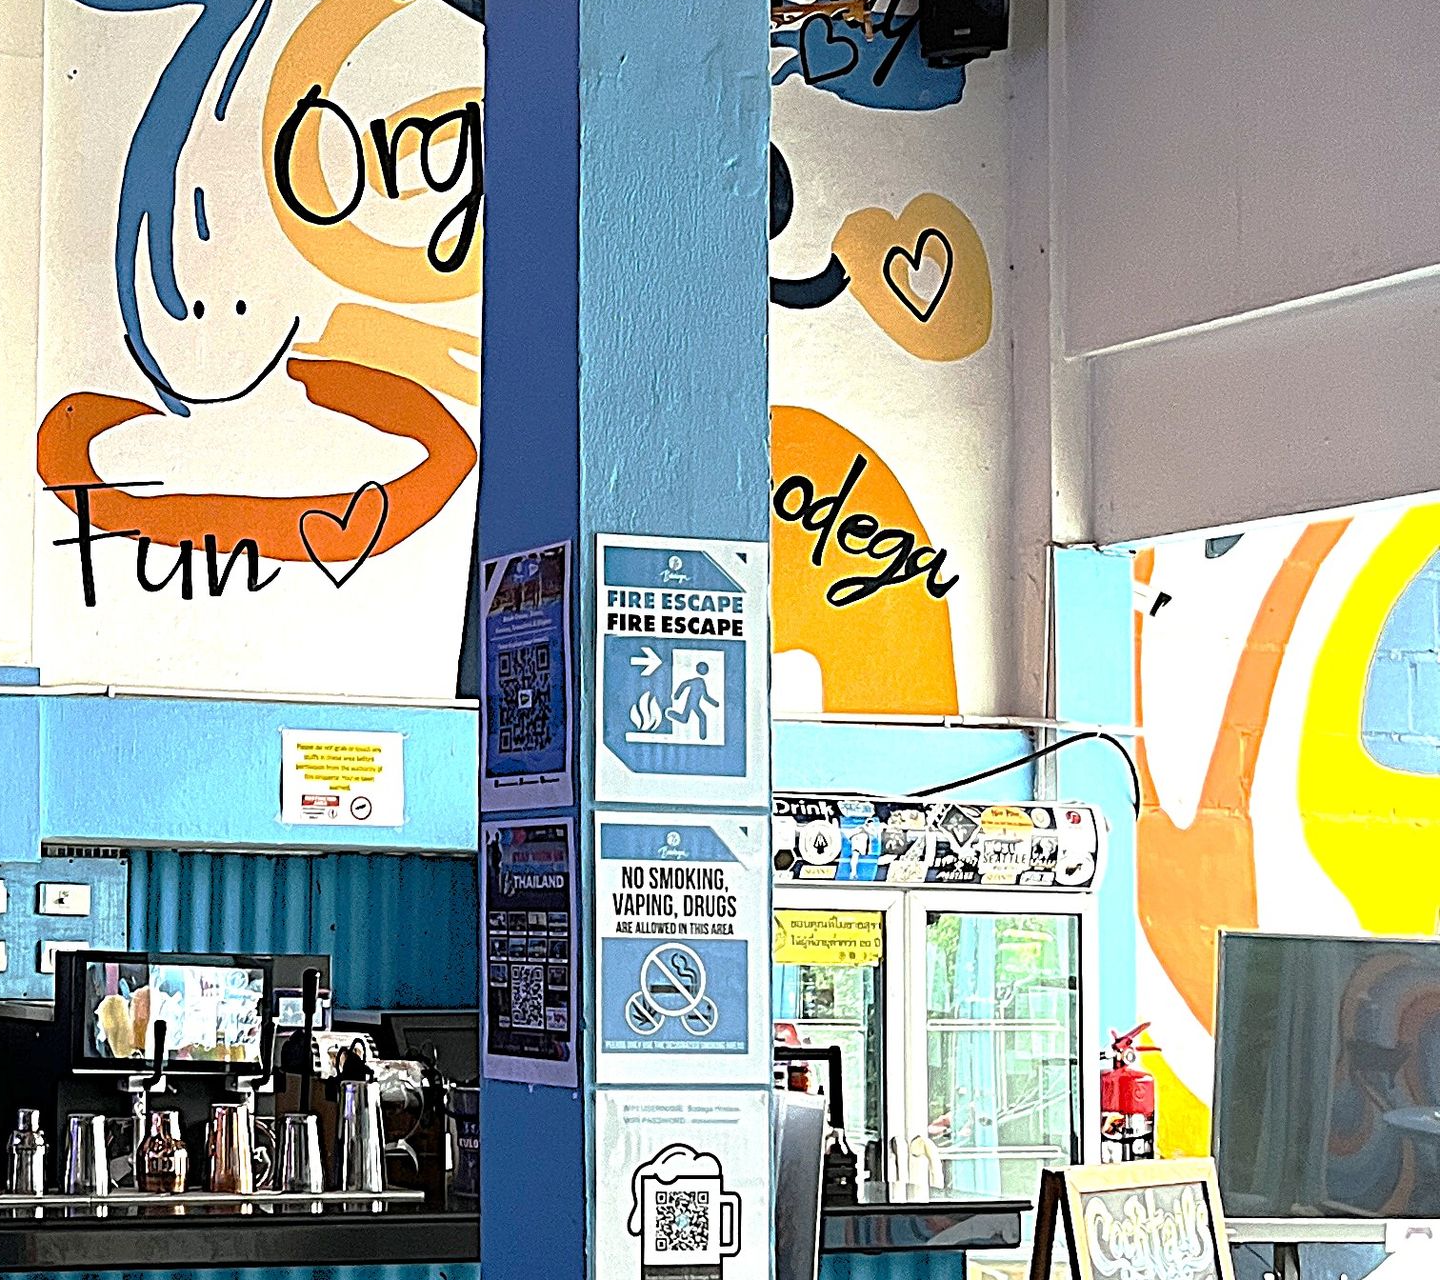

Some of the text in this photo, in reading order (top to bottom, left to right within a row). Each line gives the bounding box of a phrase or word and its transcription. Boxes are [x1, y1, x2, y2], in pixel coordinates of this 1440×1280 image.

[274, 84, 483, 273] Org
[772, 454, 959, 607] odega
[43, 481, 281, 607] Fun
[607, 589, 743, 613] FIRE ESCAPE
[607, 613, 743, 636] FIRE ESCAPE
[513, 874, 564, 889] THAILAND
[622, 866, 729, 893] NO SMOKING,
[612, 893, 737, 919] VAPING, DRUGS
[616, 921, 734, 935] ARE ALLOWED IN THIS AREA
